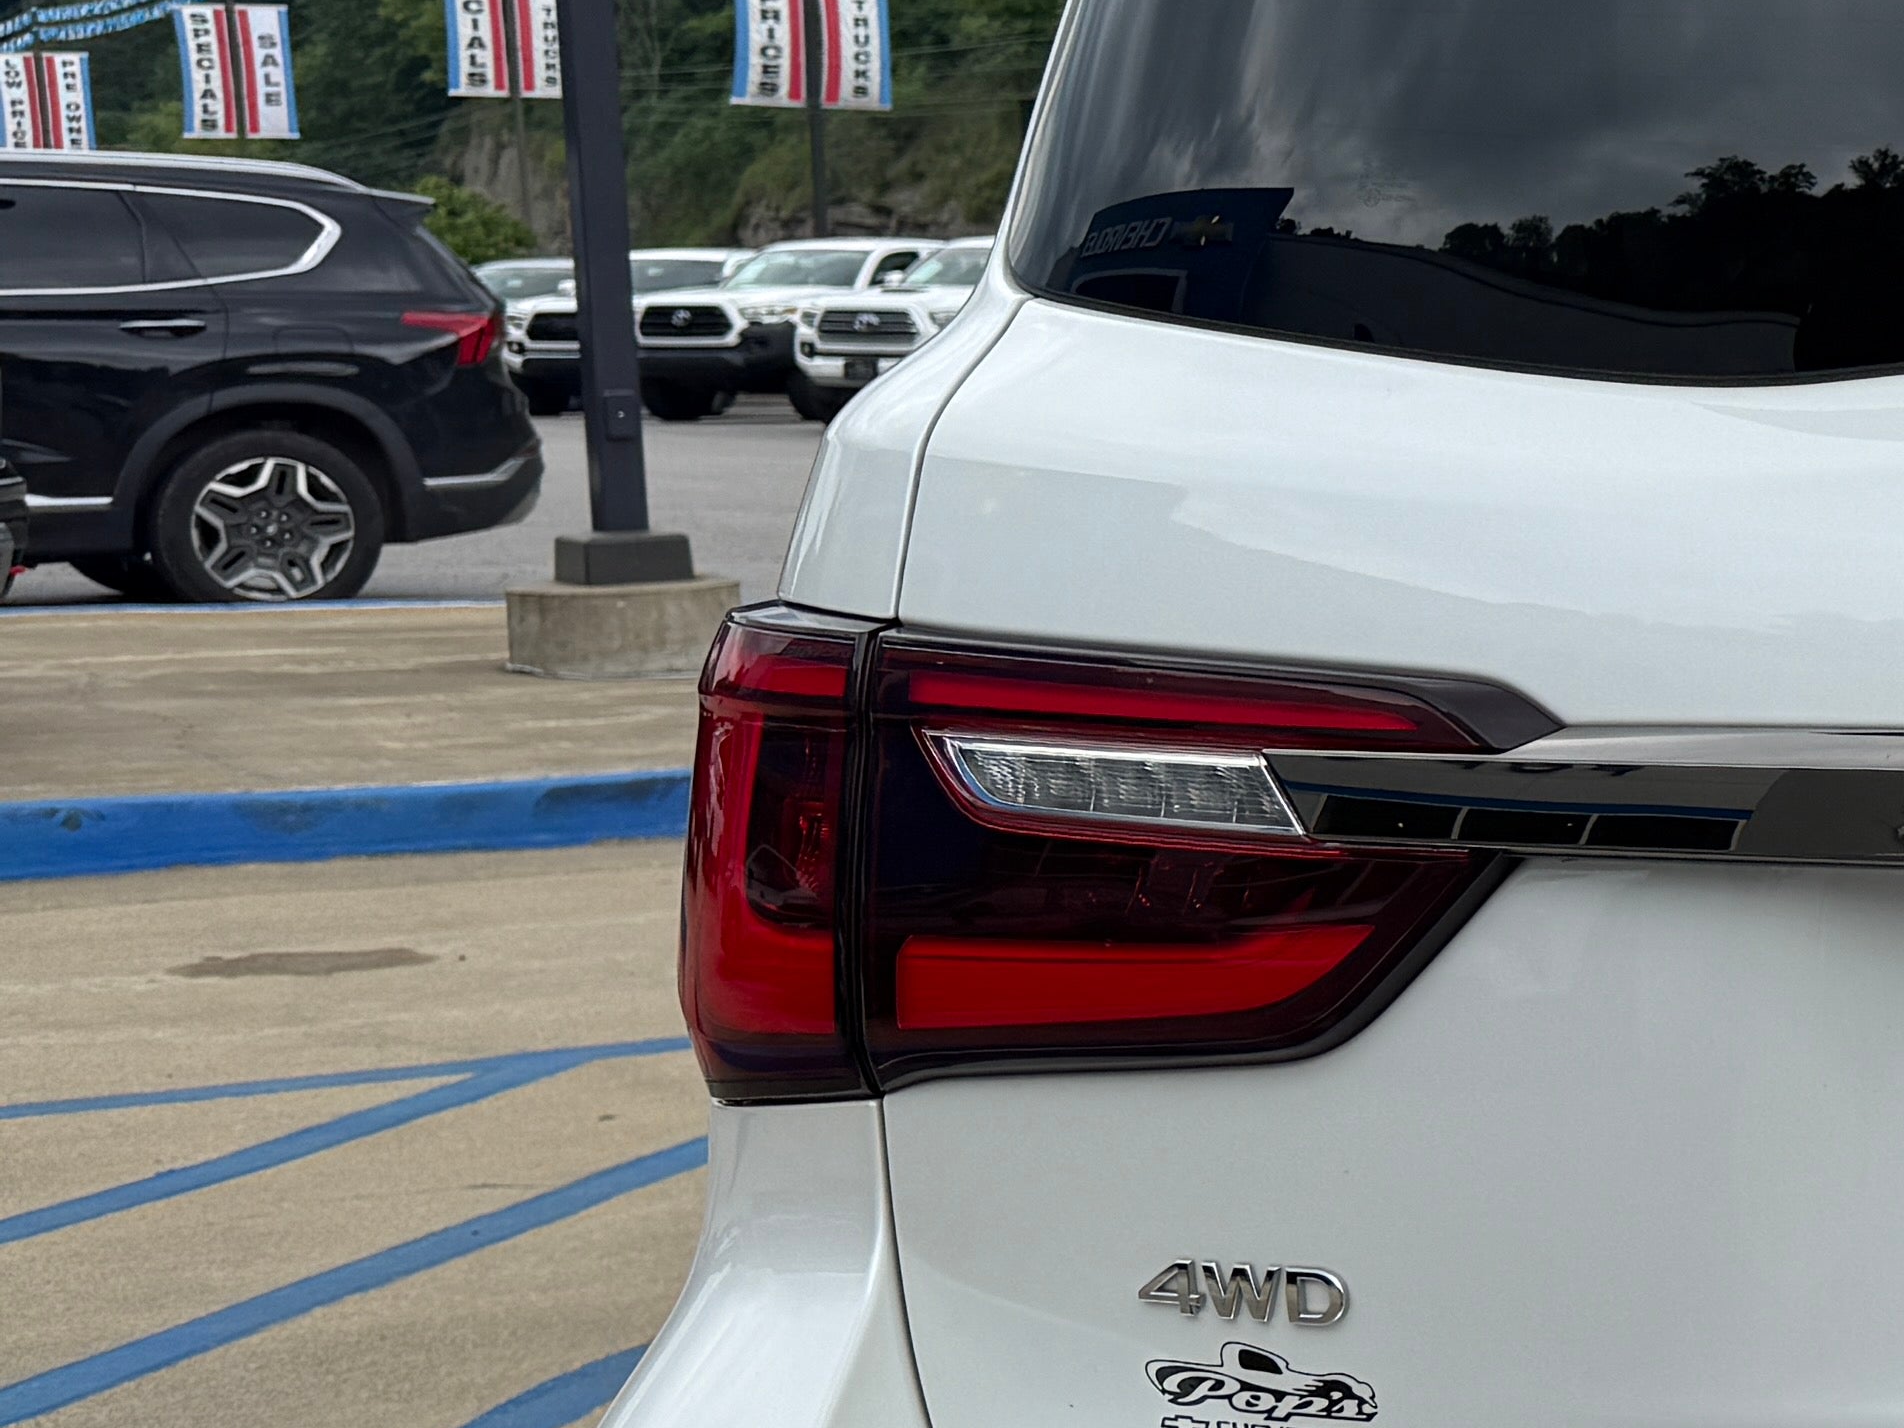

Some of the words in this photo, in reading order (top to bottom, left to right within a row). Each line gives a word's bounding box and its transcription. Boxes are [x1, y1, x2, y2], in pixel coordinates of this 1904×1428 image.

[189, 12, 219, 132] SPECIALS
[257, 32, 283, 107] SALE
[542, 4, 558, 88] TRUCKS
[10, 98, 27, 149] PRICE
[65, 101, 83, 147] OWNE
[1138, 1258, 1351, 1327] 4WD
